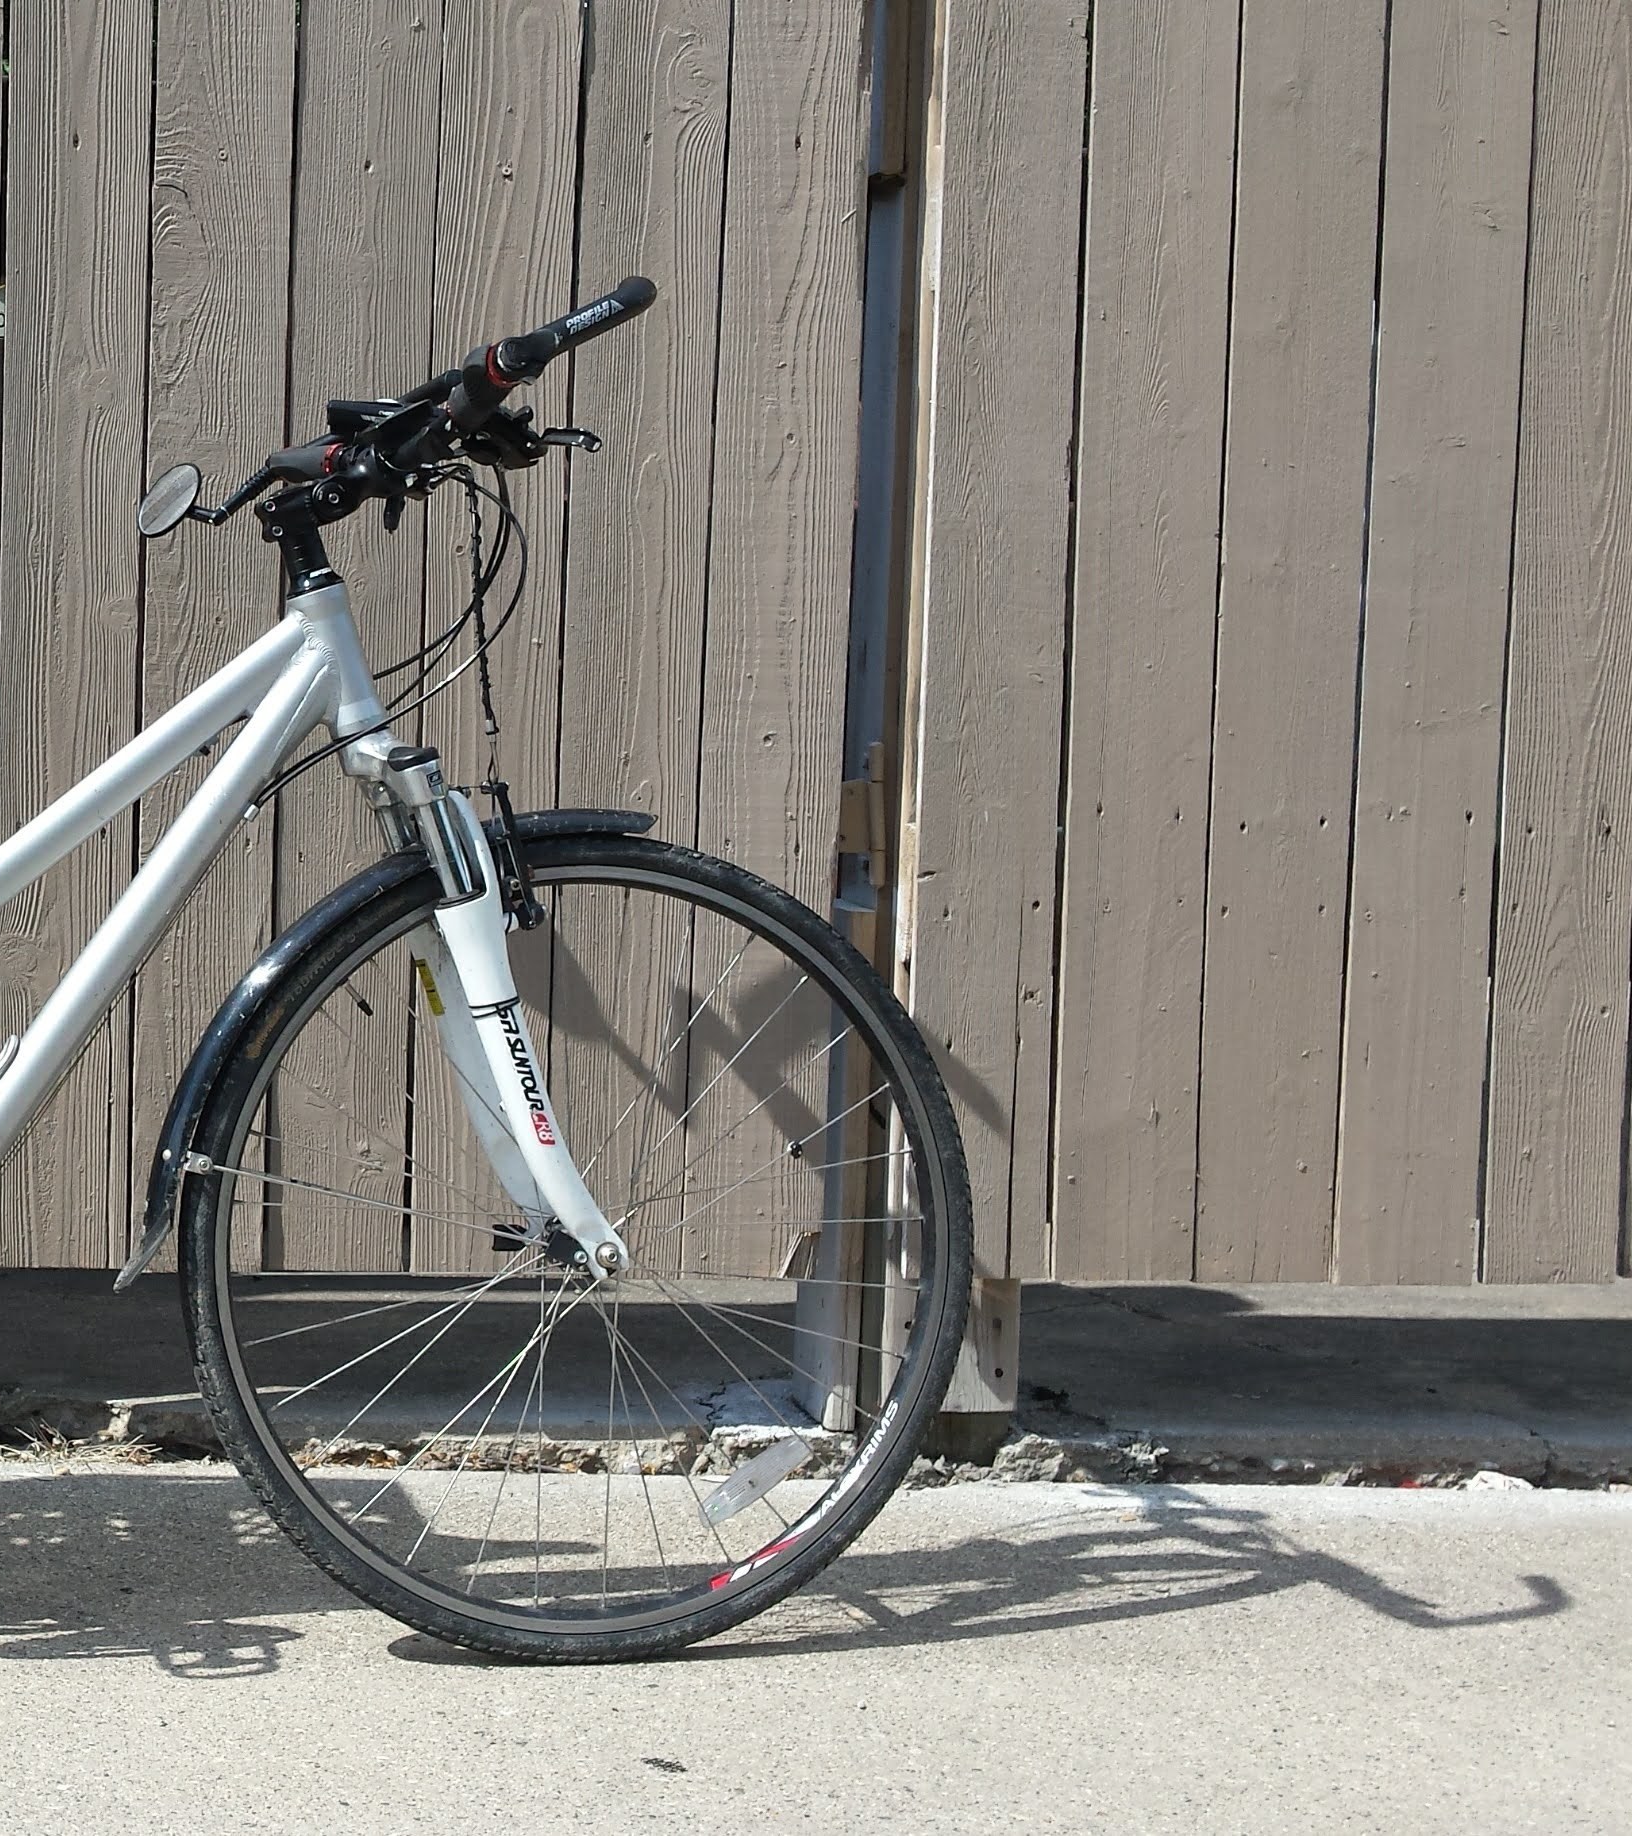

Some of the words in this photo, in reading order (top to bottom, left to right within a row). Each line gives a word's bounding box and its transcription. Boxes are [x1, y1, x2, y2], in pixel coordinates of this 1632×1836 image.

[566, 300, 609, 328] PROFILE
[570, 309, 609, 334] DESIGN
[506, 1036, 544, 1112] SUNTOUR
